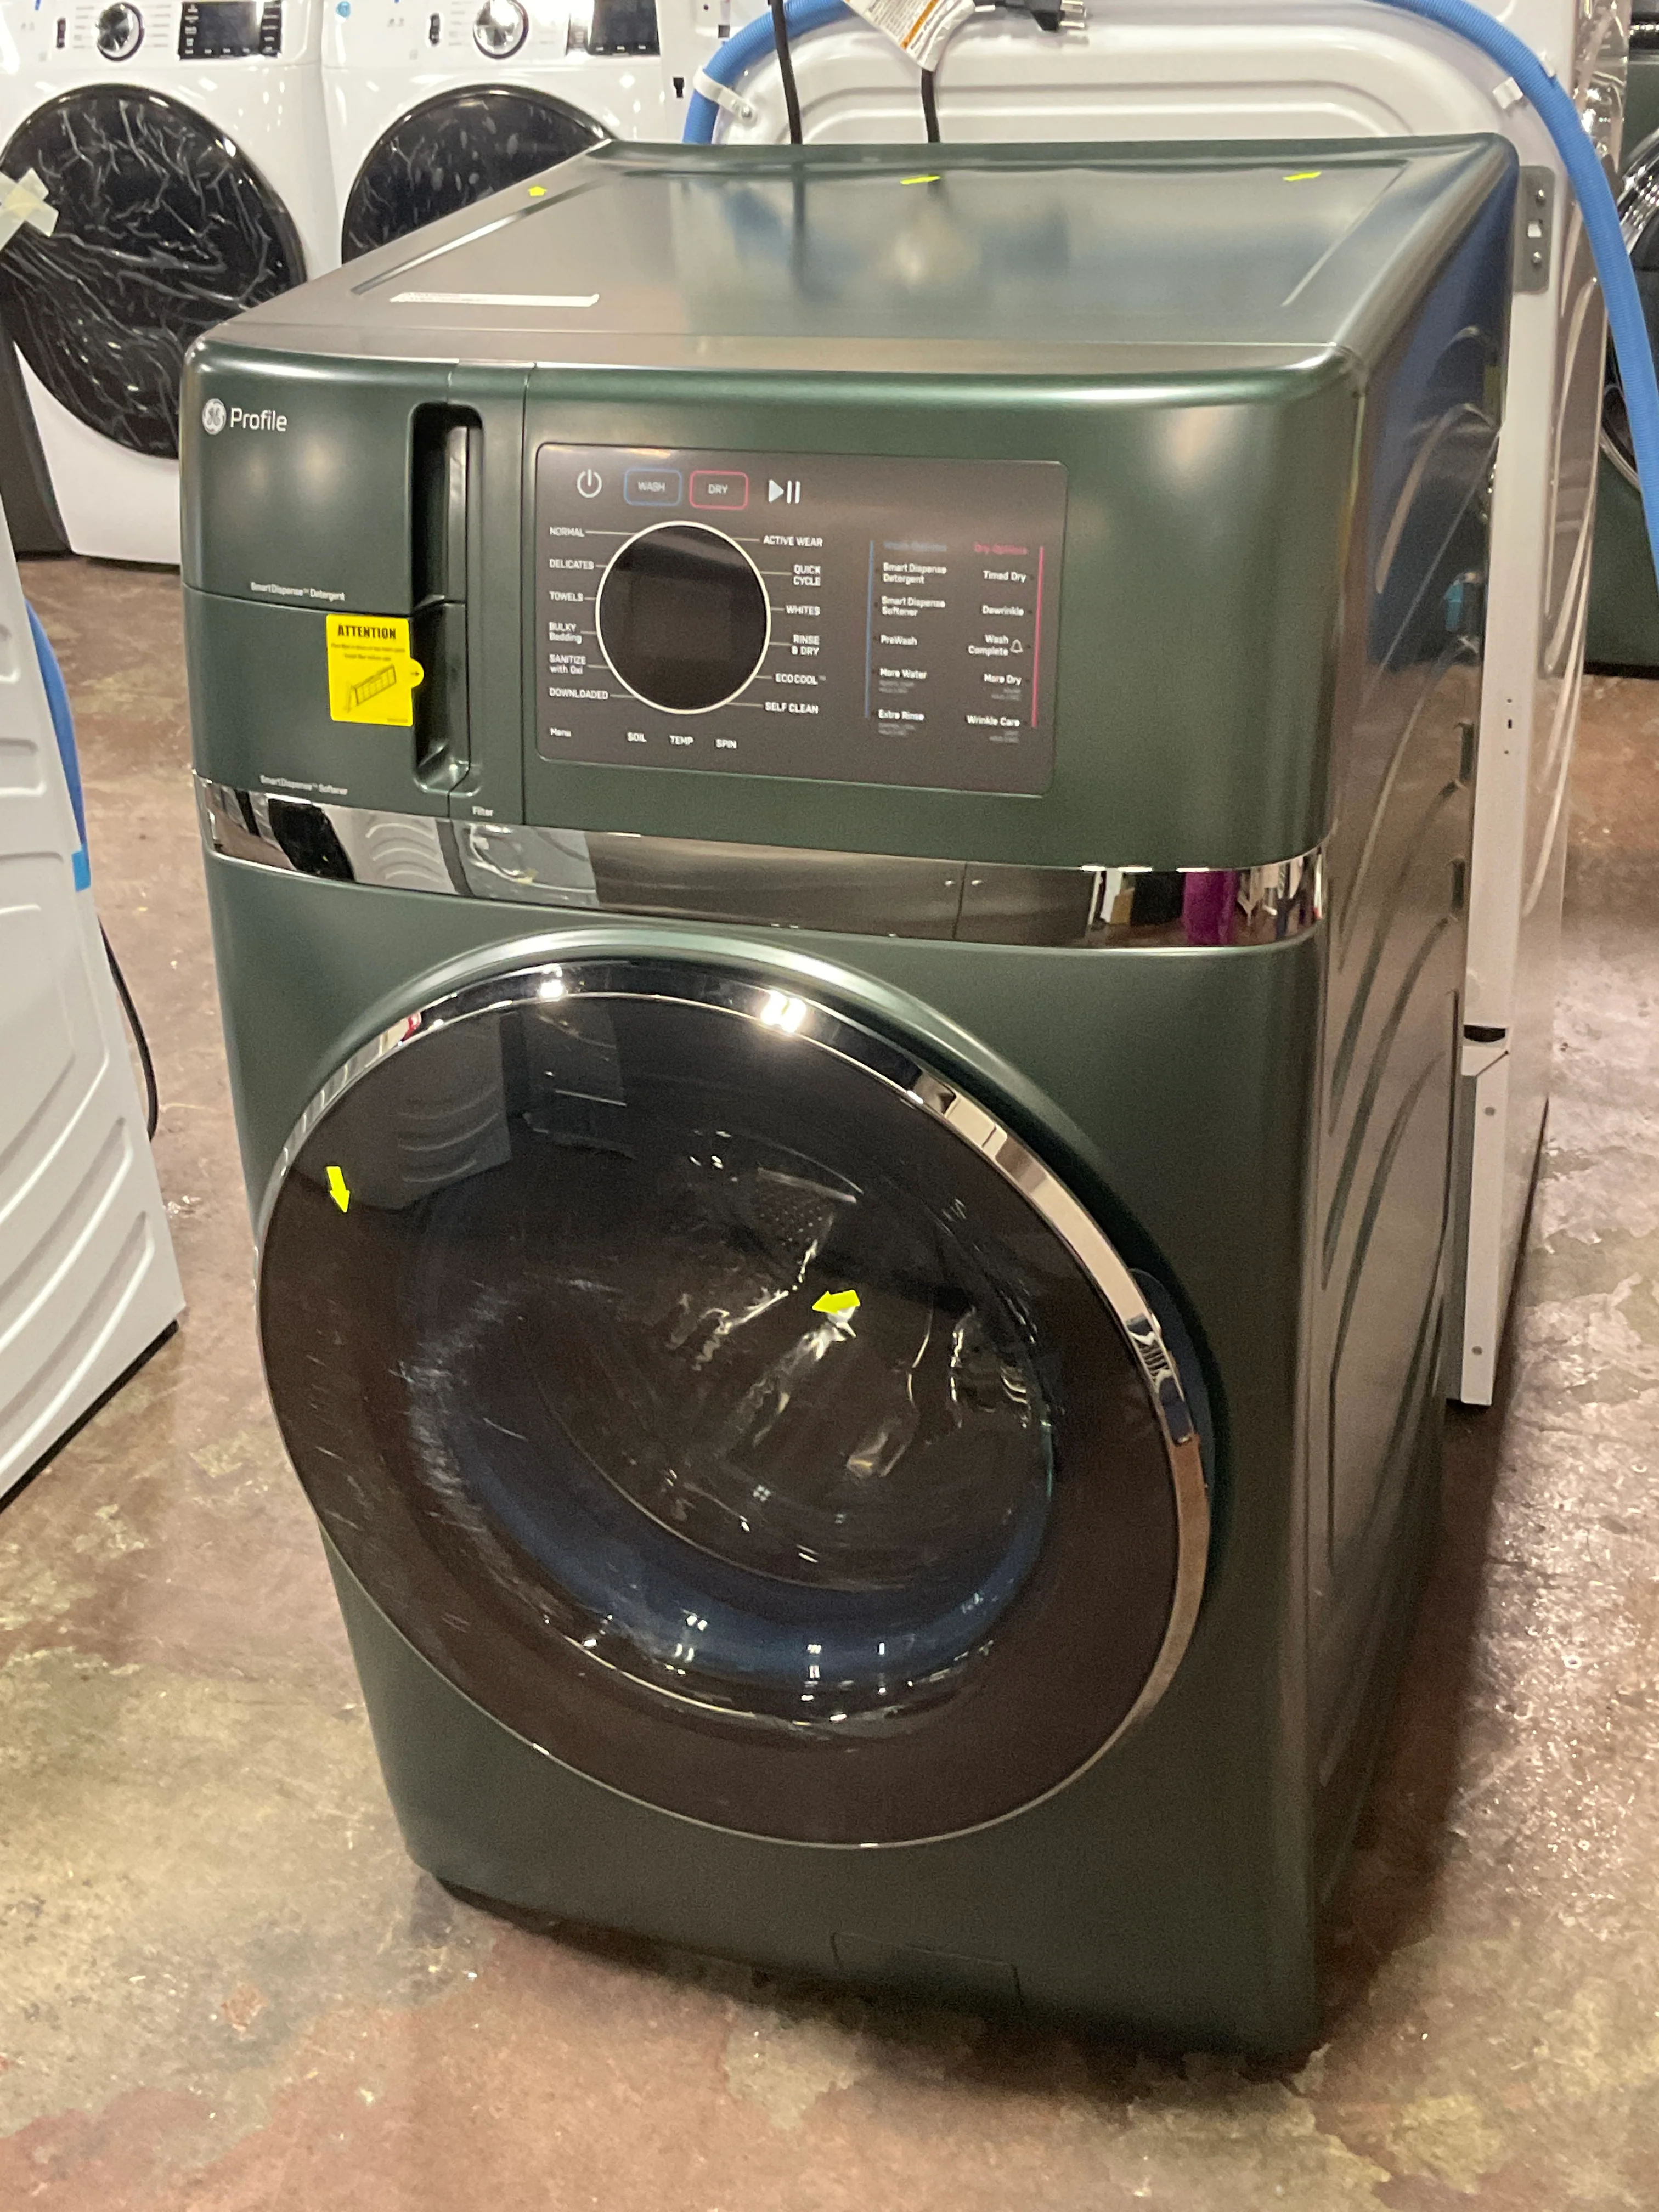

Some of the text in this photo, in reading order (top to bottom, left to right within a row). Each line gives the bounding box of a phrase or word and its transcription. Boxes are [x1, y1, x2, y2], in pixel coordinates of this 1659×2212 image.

[230, 407, 287, 432] Profile
[637, 481, 665, 492] WASH
[708, 484, 728, 494] DRY
[549, 526, 585, 538] NORMAL
[763, 535, 823, 547] ACTIVE WEAR
[549, 558, 594, 570] DELICATES
[794, 564, 821, 575] QUICK
[883, 562, 947, 574] Smart Dispense
[793, 575, 821, 586] CYCLE
[883, 572, 925, 585] Detergent
[983, 570, 1026, 583] Timed Dry
[549, 591, 584, 602] TOWELS
[881, 595, 946, 608] Smart Dispense
[786, 605, 820, 616] WHITES
[882, 605, 918, 616] Softener
[982, 605, 1024, 616] Dewrinkle
[549, 621, 577, 632] BULKY
[337, 625, 396, 640] ATTENTION
[549, 633, 582, 645] Bedding
[793, 634, 820, 645] RINSE
[985, 634, 1009, 644] Wash
[800, 646, 820, 656] DRY
[968, 645, 1009, 657] Complete
[549, 653, 586, 665] SANITIZE
[549, 664, 583, 675] with Oxi
[880, 668, 927, 679] More Water
[984, 673, 1022, 686] More Dry
[549, 687, 608, 700] DOWNLOADED
[765, 701, 819, 714] SELF CLEAN
[878, 709, 900, 720] Extra
[966, 715, 1020, 727] Wrinkle Care
[550, 727, 572, 737] Menu
[627, 732, 647, 743] SOIL
[669, 735, 694, 746] TEMP
[716, 738, 737, 749] SPIN
